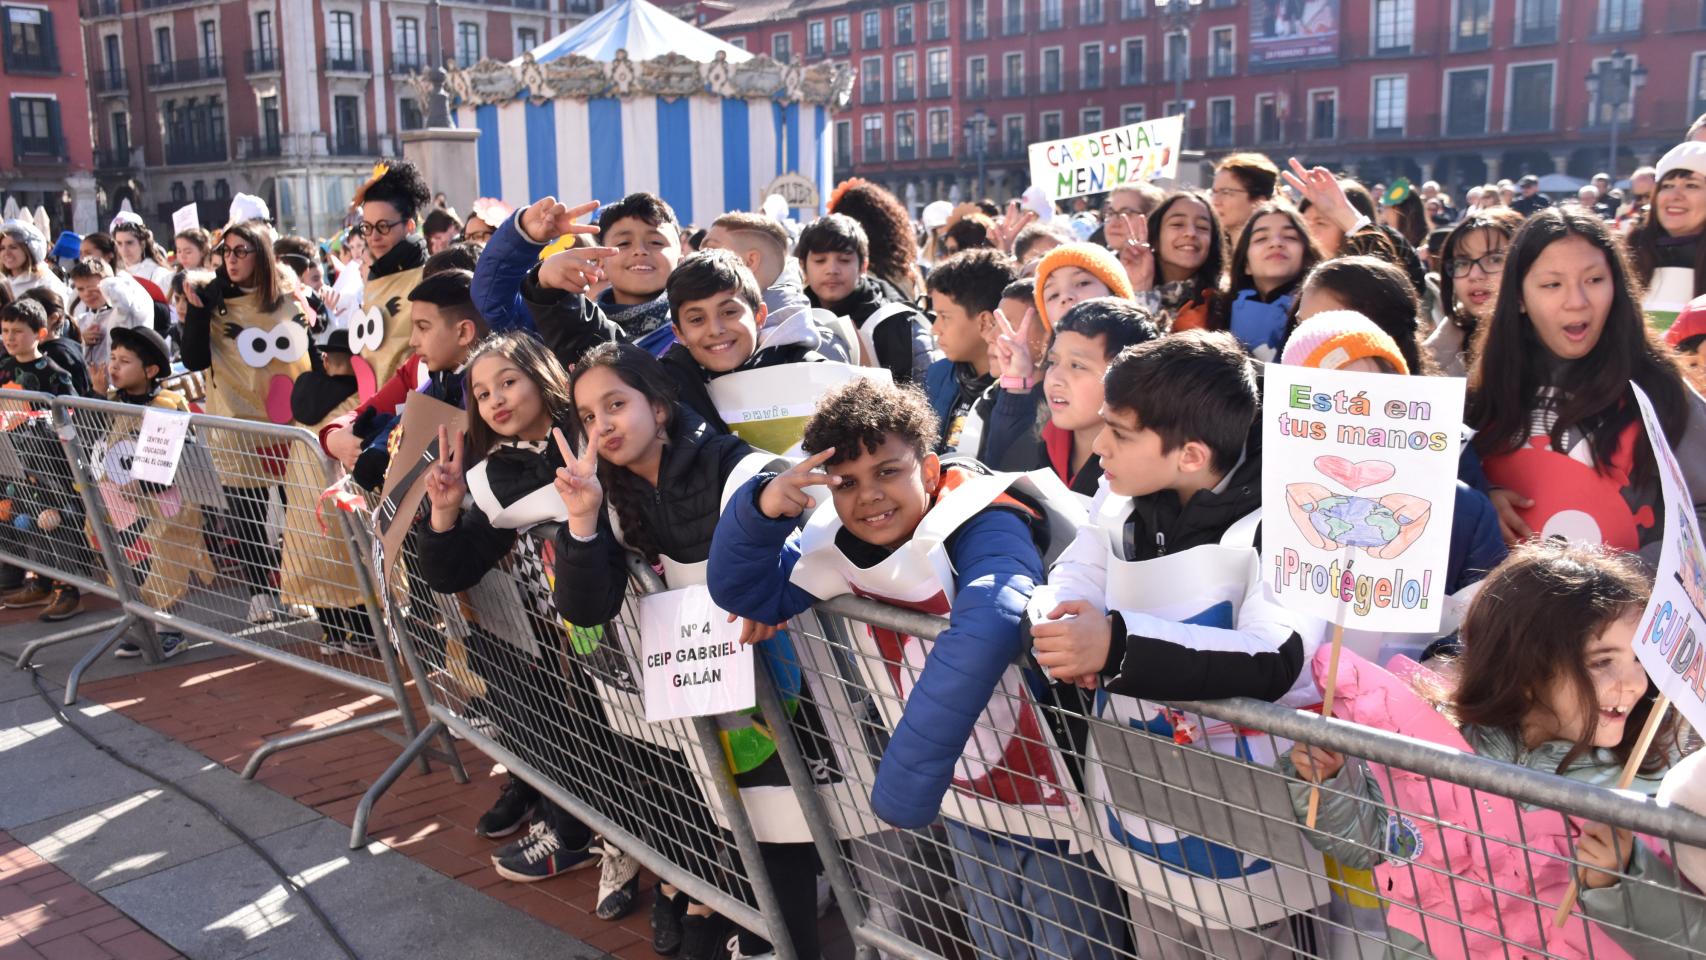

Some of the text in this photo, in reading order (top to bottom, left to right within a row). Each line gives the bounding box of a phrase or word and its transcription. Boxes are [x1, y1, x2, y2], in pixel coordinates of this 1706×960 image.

[1047, 125, 1162, 166] CARDENAL
[1289, 384, 1432, 420] Está en
[1278, 412, 1448, 452] tus manos
[1274, 547, 1432, 616] ¡Protégelo!
[702, 621, 711, 635] 4
[647, 651, 672, 668] CEIP
[675, 641, 736, 663] GABRIEL
[672, 667, 722, 688] GALÁN
